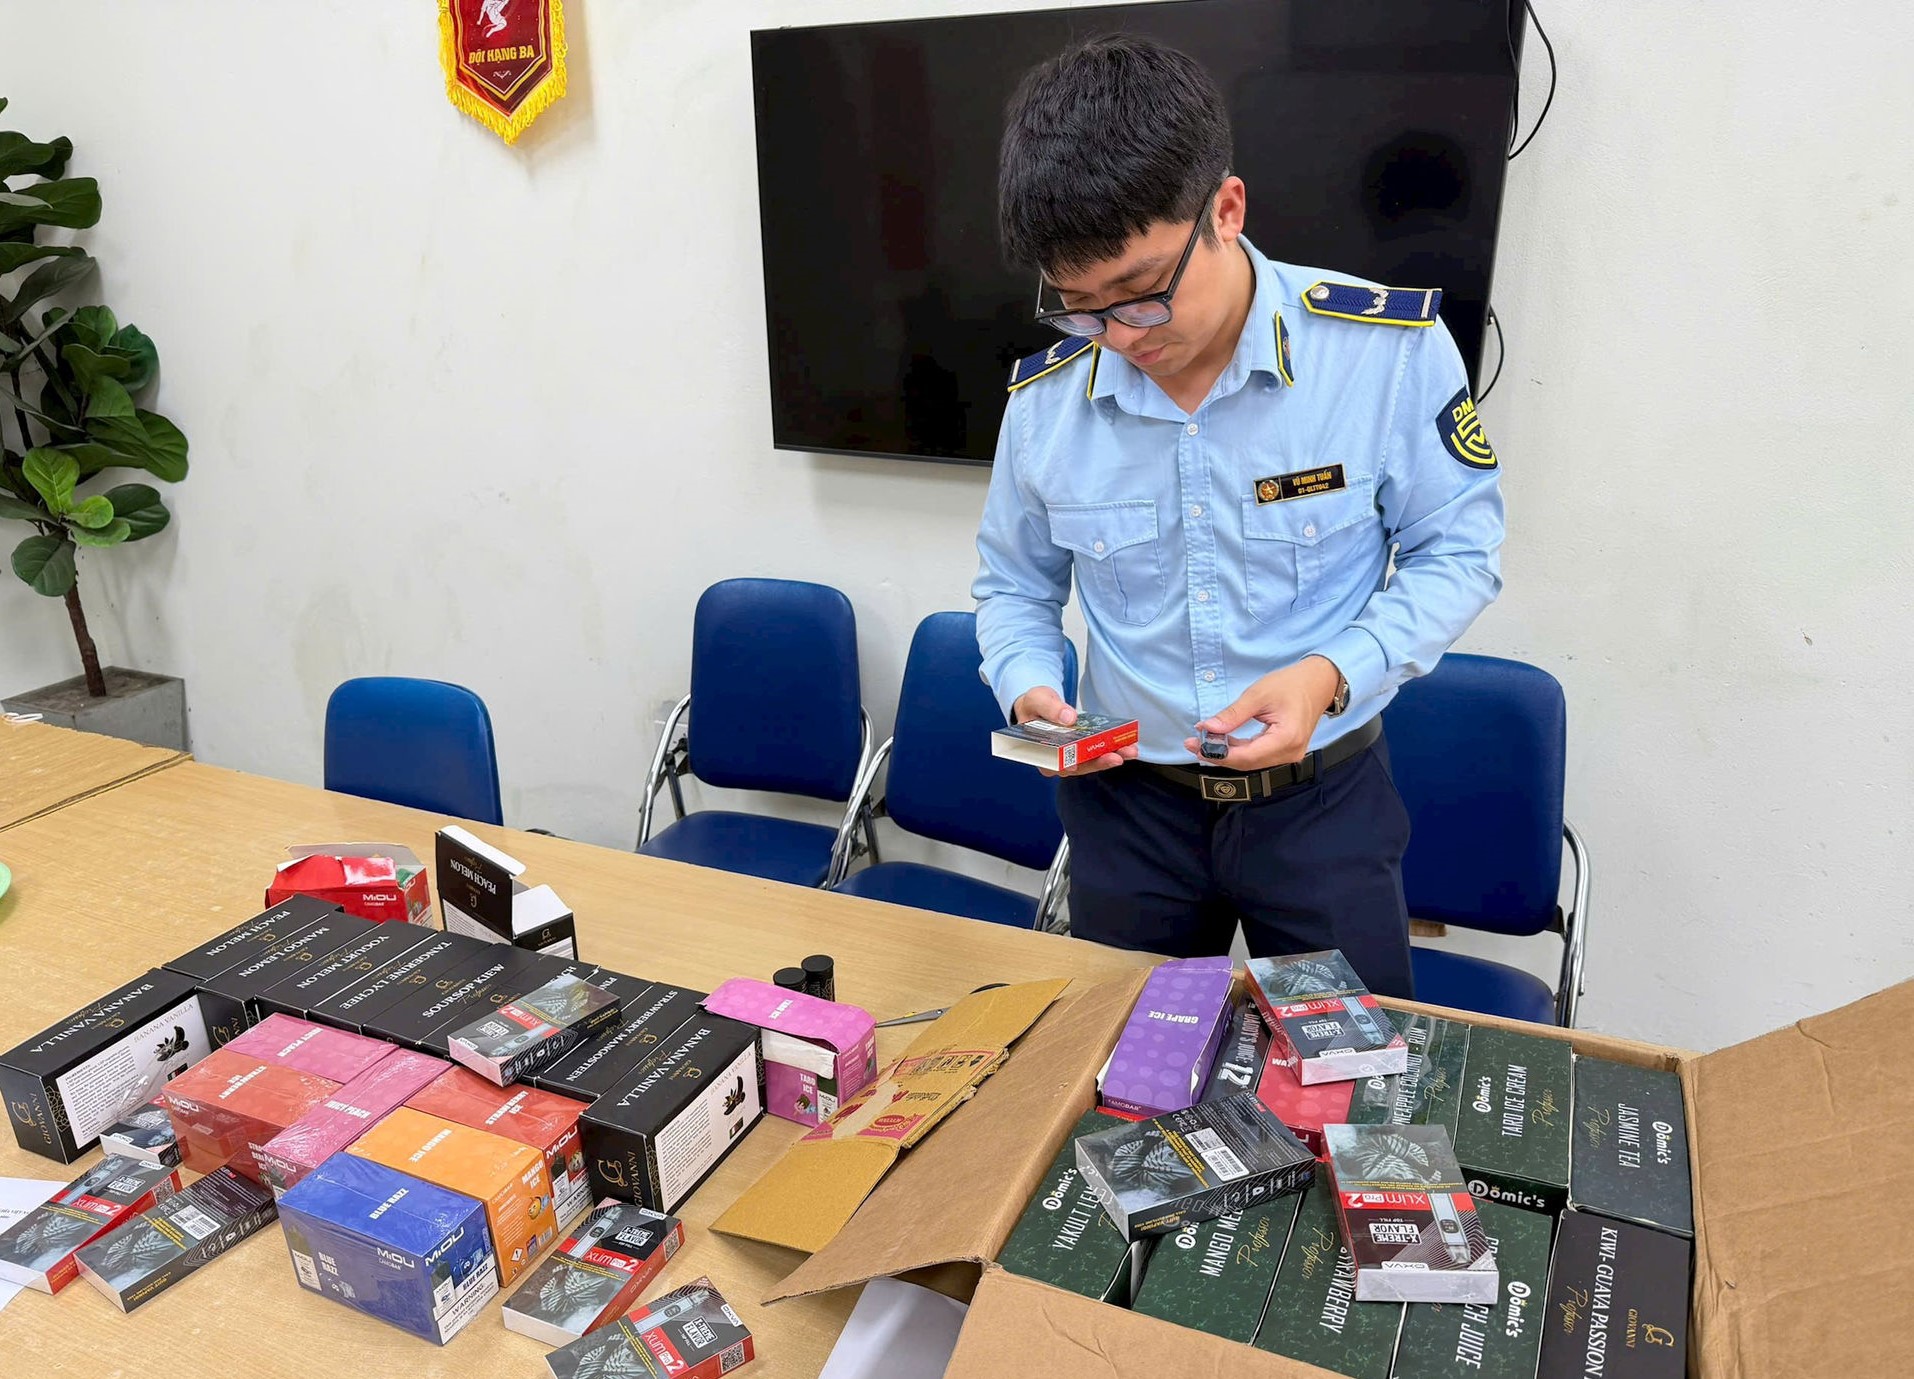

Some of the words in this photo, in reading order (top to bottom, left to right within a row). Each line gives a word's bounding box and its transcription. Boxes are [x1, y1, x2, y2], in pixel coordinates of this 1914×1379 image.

[468, 48, 485, 65] ĐỘI
[487, 47, 517, 63] HẠNG
[519, 45, 534, 59] BA
[1451, 398, 1475, 422] DM
[450, 858, 469, 876] MELON
[469, 870, 496, 895] PEACH
[250, 910, 291, 934] PEACH
[206, 930, 251, 956] MELON
[283, 926, 330, 953] MANGO
[342, 935, 390, 966] YOGURT
[238, 951, 286, 978] LEMON
[385, 941, 453, 981] TANGERINE
[297, 961, 344, 988] MELON
[93, 983, 154, 1018] BANANA
[339, 978, 389, 1010] LYCHEE
[422, 983, 475, 1018] SOURSOP
[625, 990, 678, 1034] STRAWBERRY
[1148, 1010, 1163, 1020] ICE
[1162, 1012, 1199, 1024] GRAPE
[1277, 1006, 1292, 1018] 2
[30, 1015, 97, 1054] VANILLA
[1304, 1022, 1339, 1033] FLAVOR
[566, 1032, 628, 1082] MANGOSTEEN
[662, 1028, 712, 1065] BANANA
[1322, 1048, 1354, 1056] OXVA
[616, 1066, 670, 1106] VANILLA
[800, 1073, 816, 1086] TARO
[1217, 1062, 1254, 1087] 12
[1506, 1064, 1528, 1096] CREAM
[803, 1084, 814, 1094] ICE
[484, 1090, 530, 1126] STRAWBERRY
[1504, 1096, 1525, 1115] ICE
[1502, 1115, 1524, 1138] TARO
[1618, 1103, 1640, 1148] JASMINE
[1618, 1149, 1641, 1168] TEA
[522, 1160, 544, 1184] MANGO
[530, 1174, 540, 1189] ICE
[108, 1205, 122, 1216] 2
[369, 1202, 394, 1220] BLUE
[390, 1188, 410, 1204] RAZZ
[1346, 1193, 1364, 1208] 2
[1364, 1194, 1384, 1203] Pro
[641, 1208, 664, 1220] OXVA
[618, 1233, 646, 1246] FLAVOR
[624, 1226, 652, 1238] X-TREME
[1052, 1208, 1092, 1250] YAKULT
[1373, 1224, 1415, 1234] FLAVOR
[1374, 1234, 1419, 1243] X-TREME
[318, 1252, 336, 1266] BLUE
[625, 1259, 638, 1271] 2
[1200, 1232, 1234, 1277] MANGO
[1594, 1263, 1614, 1309] GUAVA
[452, 1284, 484, 1315] WARNING
[722, 1306, 740, 1326] OXVA
[683, 1324, 706, 1348] FLAVOR
[694, 1318, 716, 1342] X-TREME
[1626, 1308, 1638, 1349] GIOVANNI
[1455, 1323, 1486, 1370] JUICE
[1585, 1310, 1609, 1378] PASSION
[670, 1360, 685, 1374] 2
